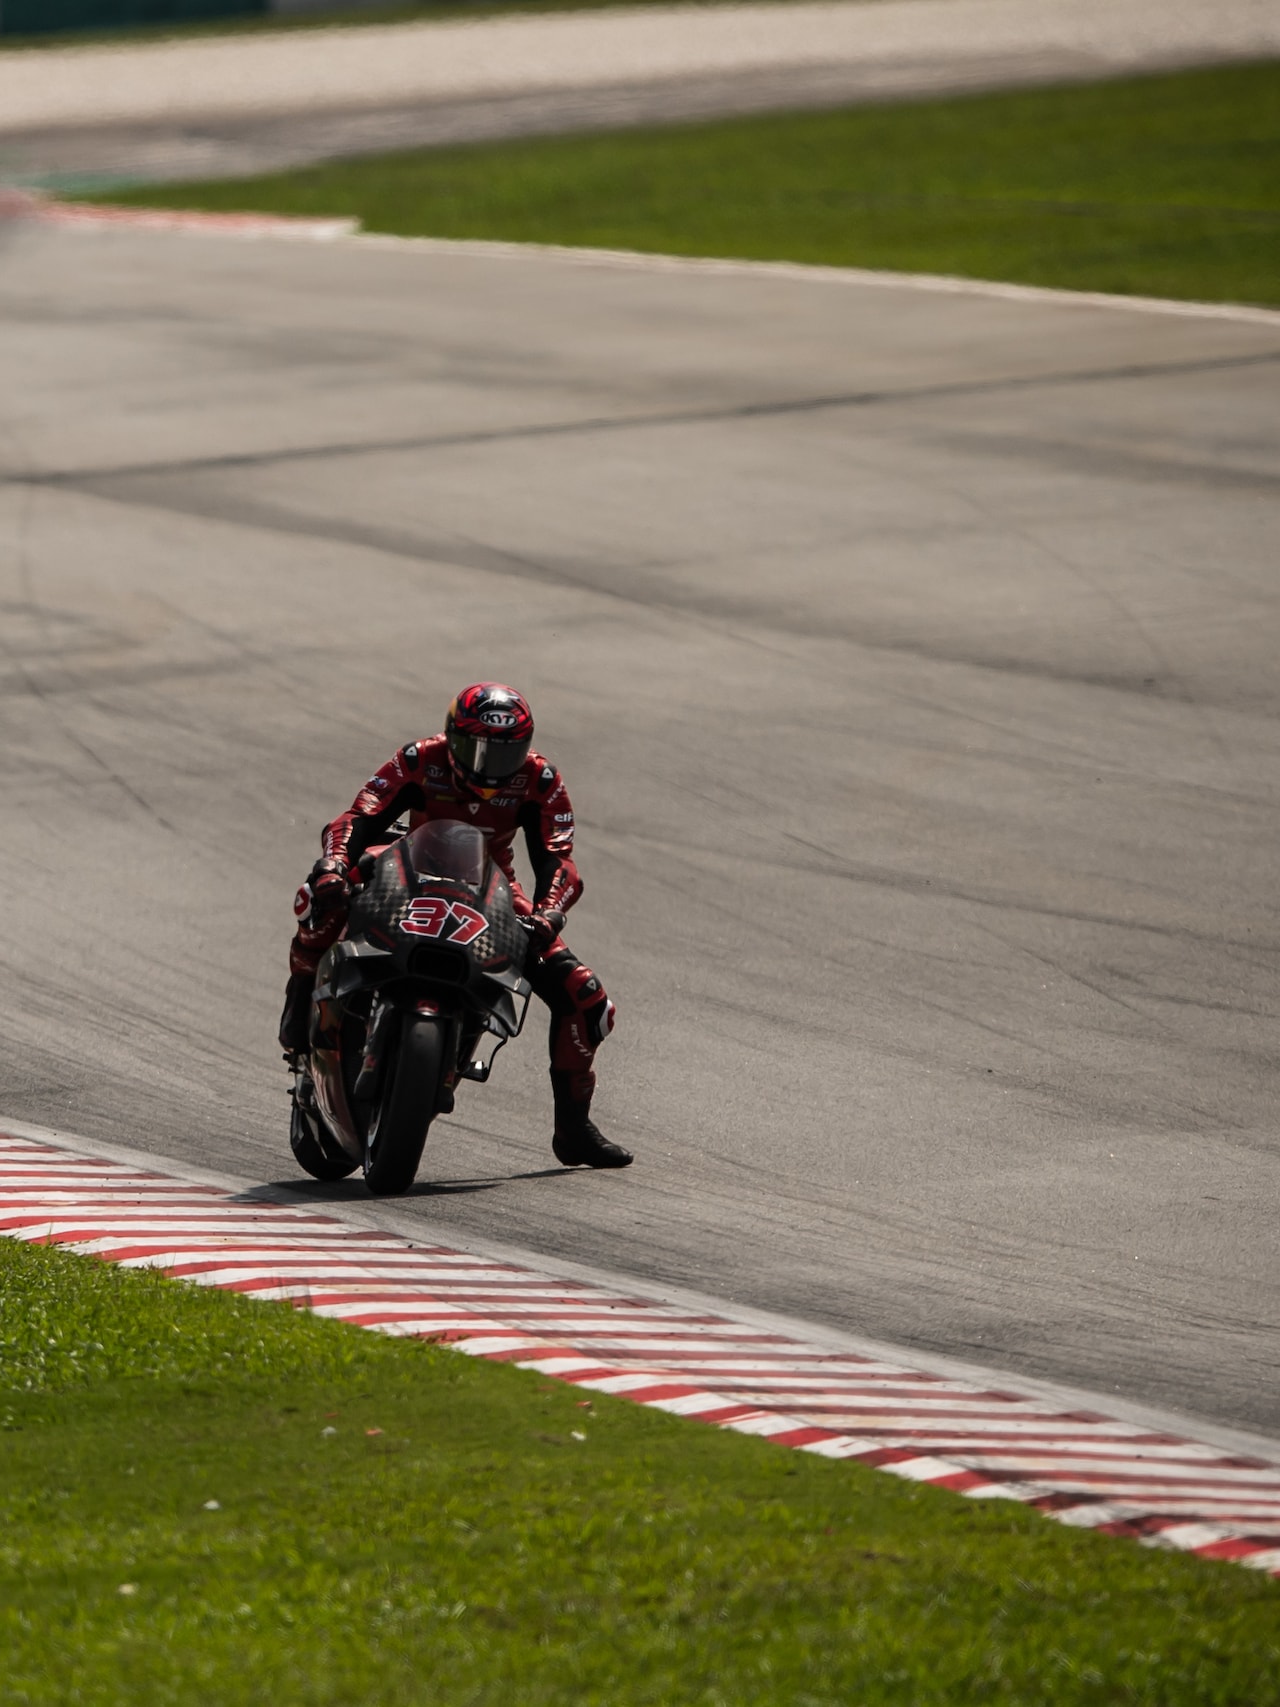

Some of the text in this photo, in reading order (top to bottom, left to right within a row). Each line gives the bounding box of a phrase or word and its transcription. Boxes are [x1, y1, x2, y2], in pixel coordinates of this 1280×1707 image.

[482, 713, 515, 725] KYT
[489, 797, 511, 807] elf
[399, 897, 490, 945] 37
